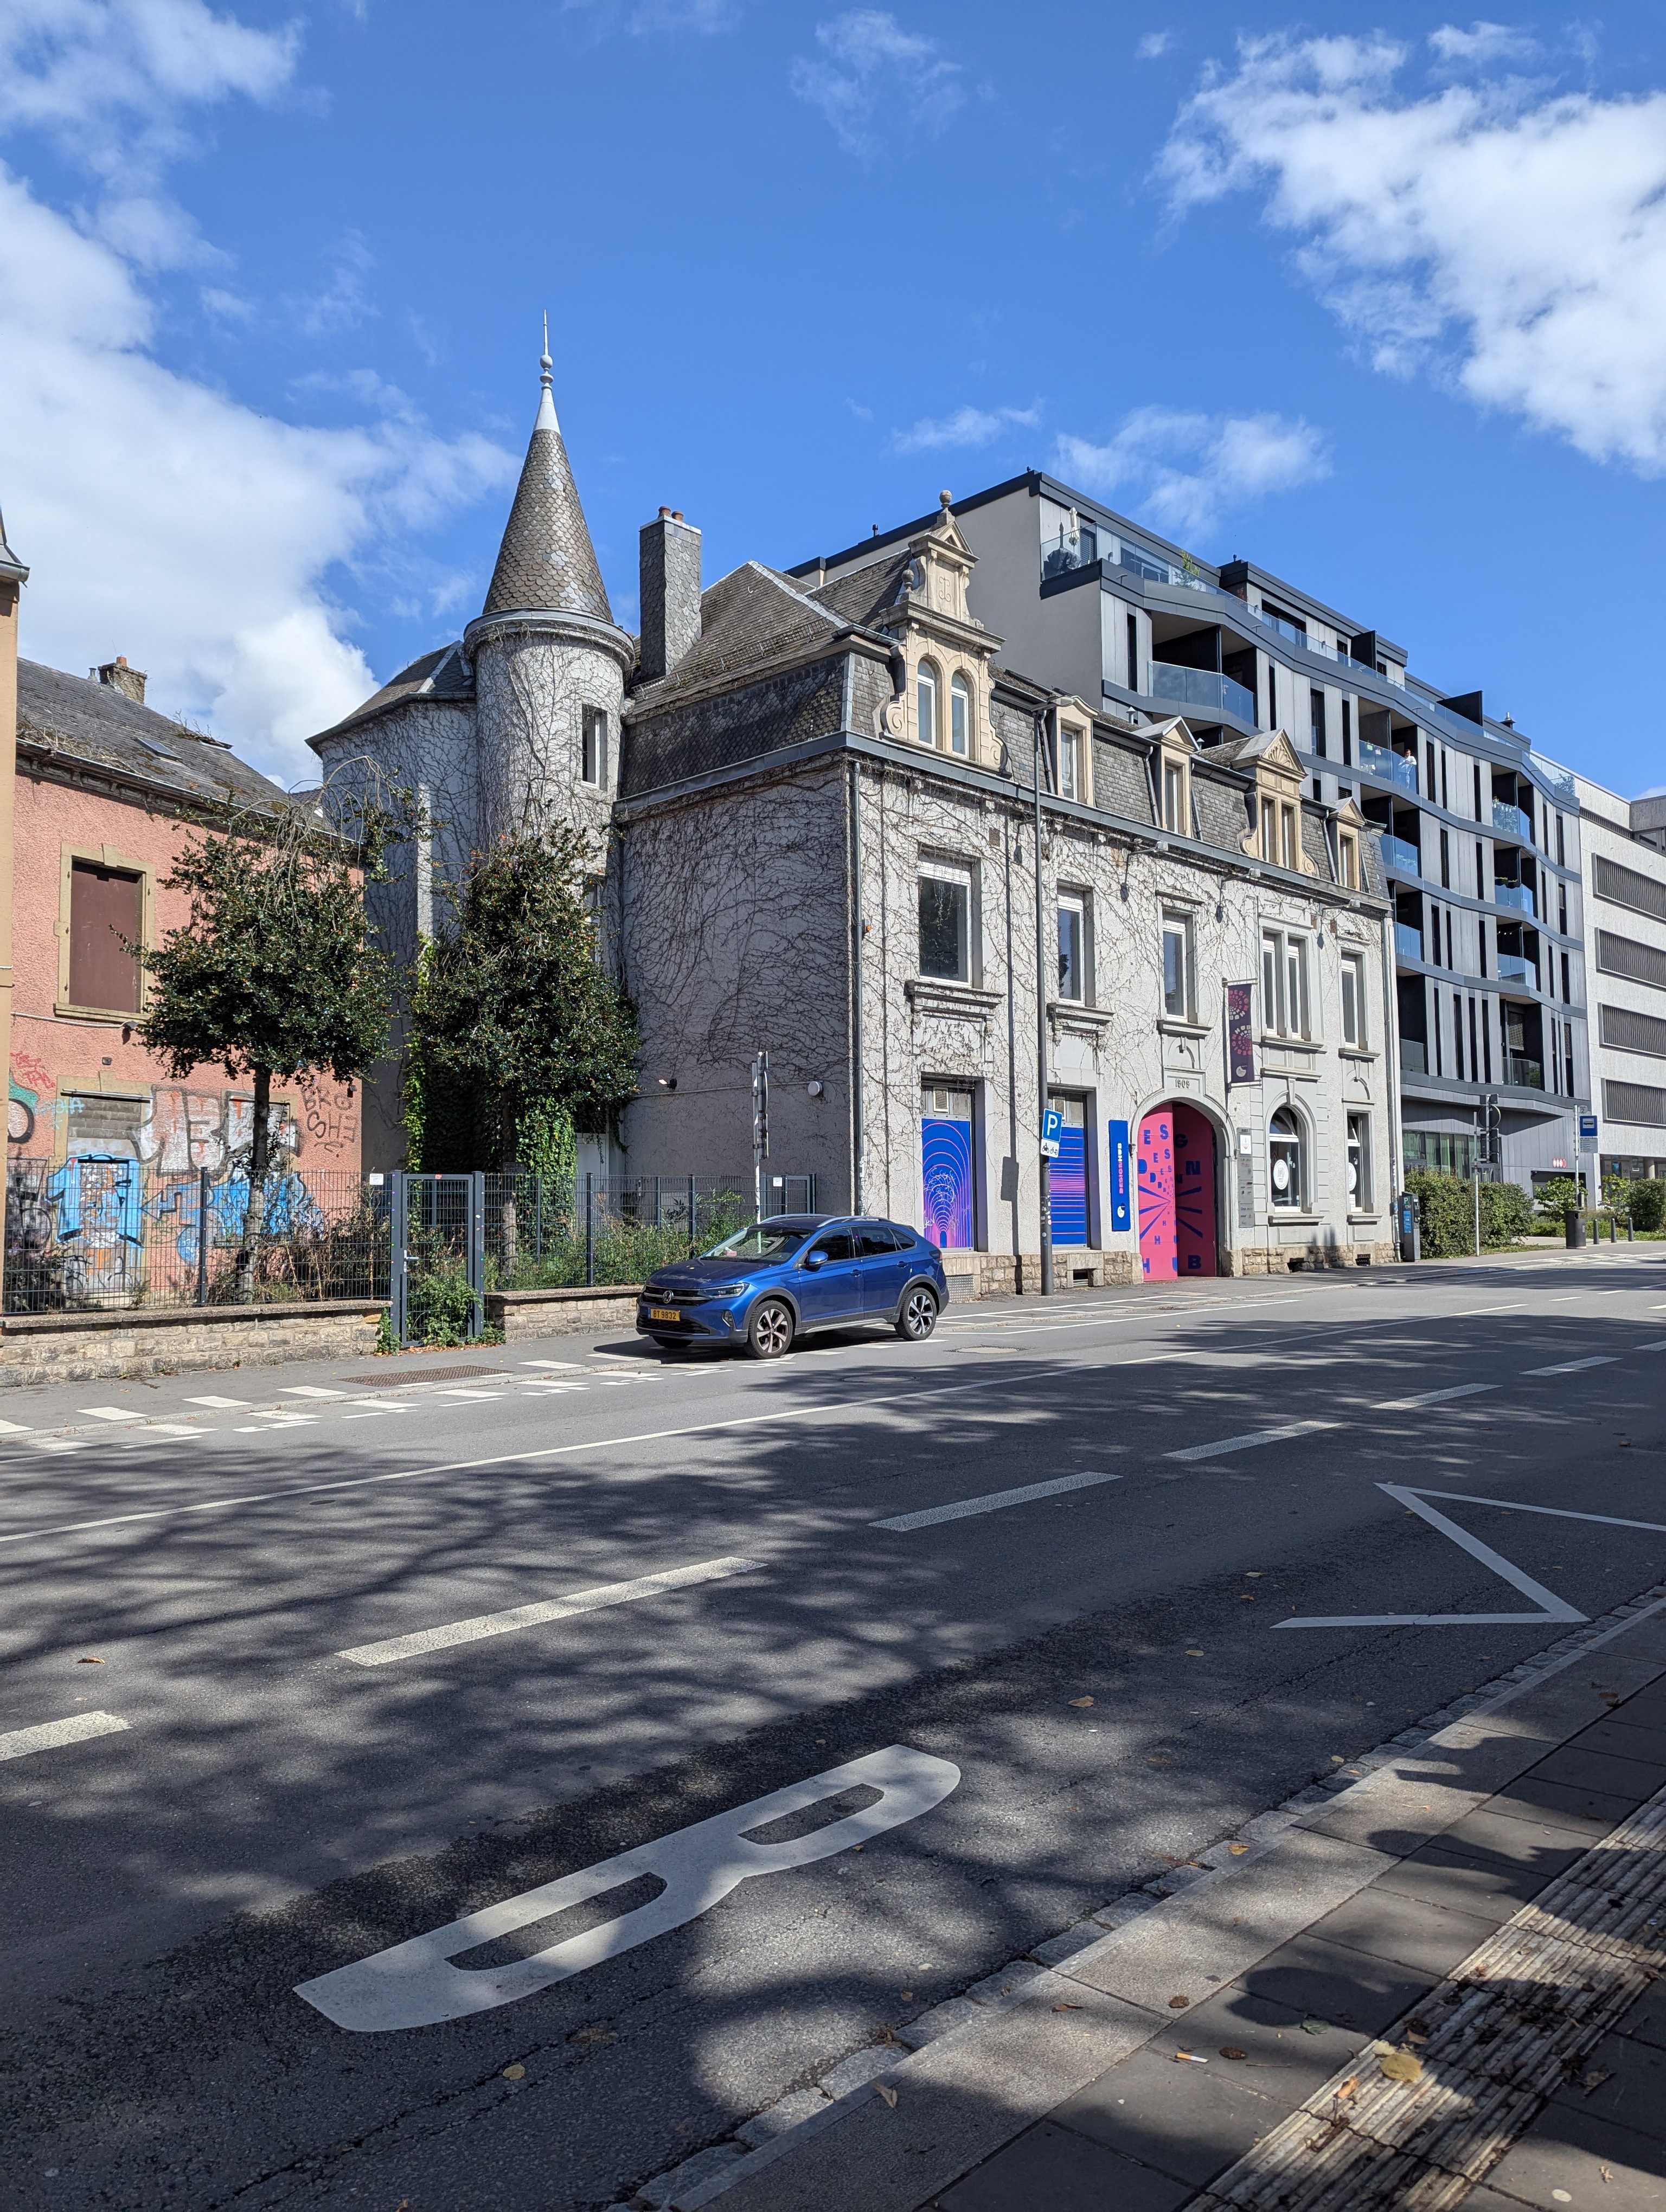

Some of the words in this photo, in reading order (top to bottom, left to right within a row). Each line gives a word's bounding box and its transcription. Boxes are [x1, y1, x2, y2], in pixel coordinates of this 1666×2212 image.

[1047, 1114, 1058, 1136] P
[1404, 1197, 1408, 1205] P
[653, 1310, 660, 1319] BT
[661, 1311, 676, 1320] 9832
